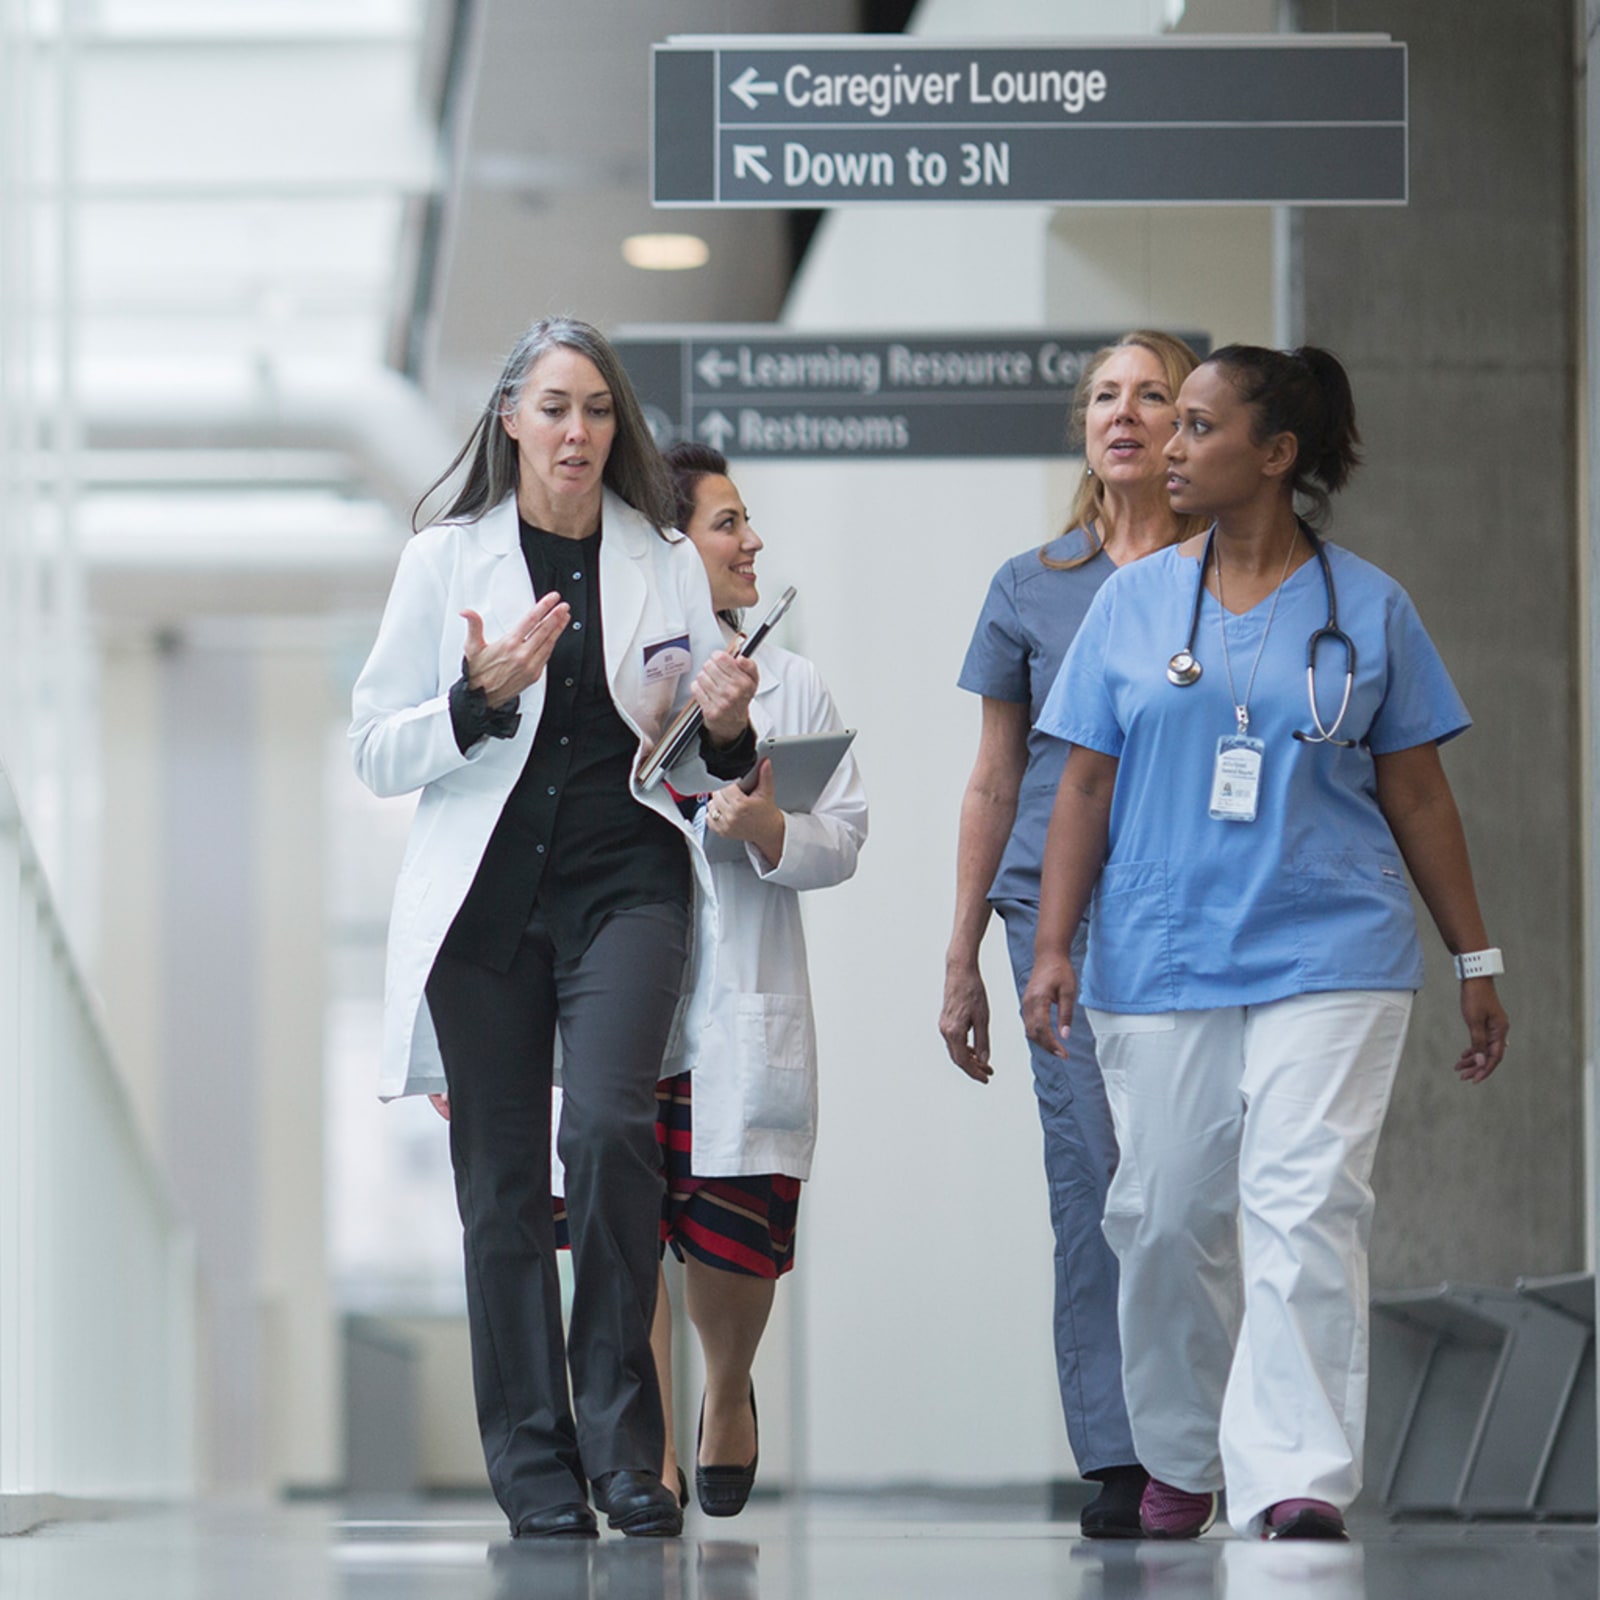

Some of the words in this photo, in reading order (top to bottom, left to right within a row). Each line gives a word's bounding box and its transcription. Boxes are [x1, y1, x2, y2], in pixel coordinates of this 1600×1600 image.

[784, 63, 960, 116] Caregiver
[969, 62, 1107, 113] Lounge
[784, 142, 894, 186] Down
[906, 147, 947, 185] to
[959, 142, 1010, 185] 3N
[740, 346, 881, 393] Learning
[888, 345, 1032, 385] Resource
[738, 409, 909, 449] Restrooms
